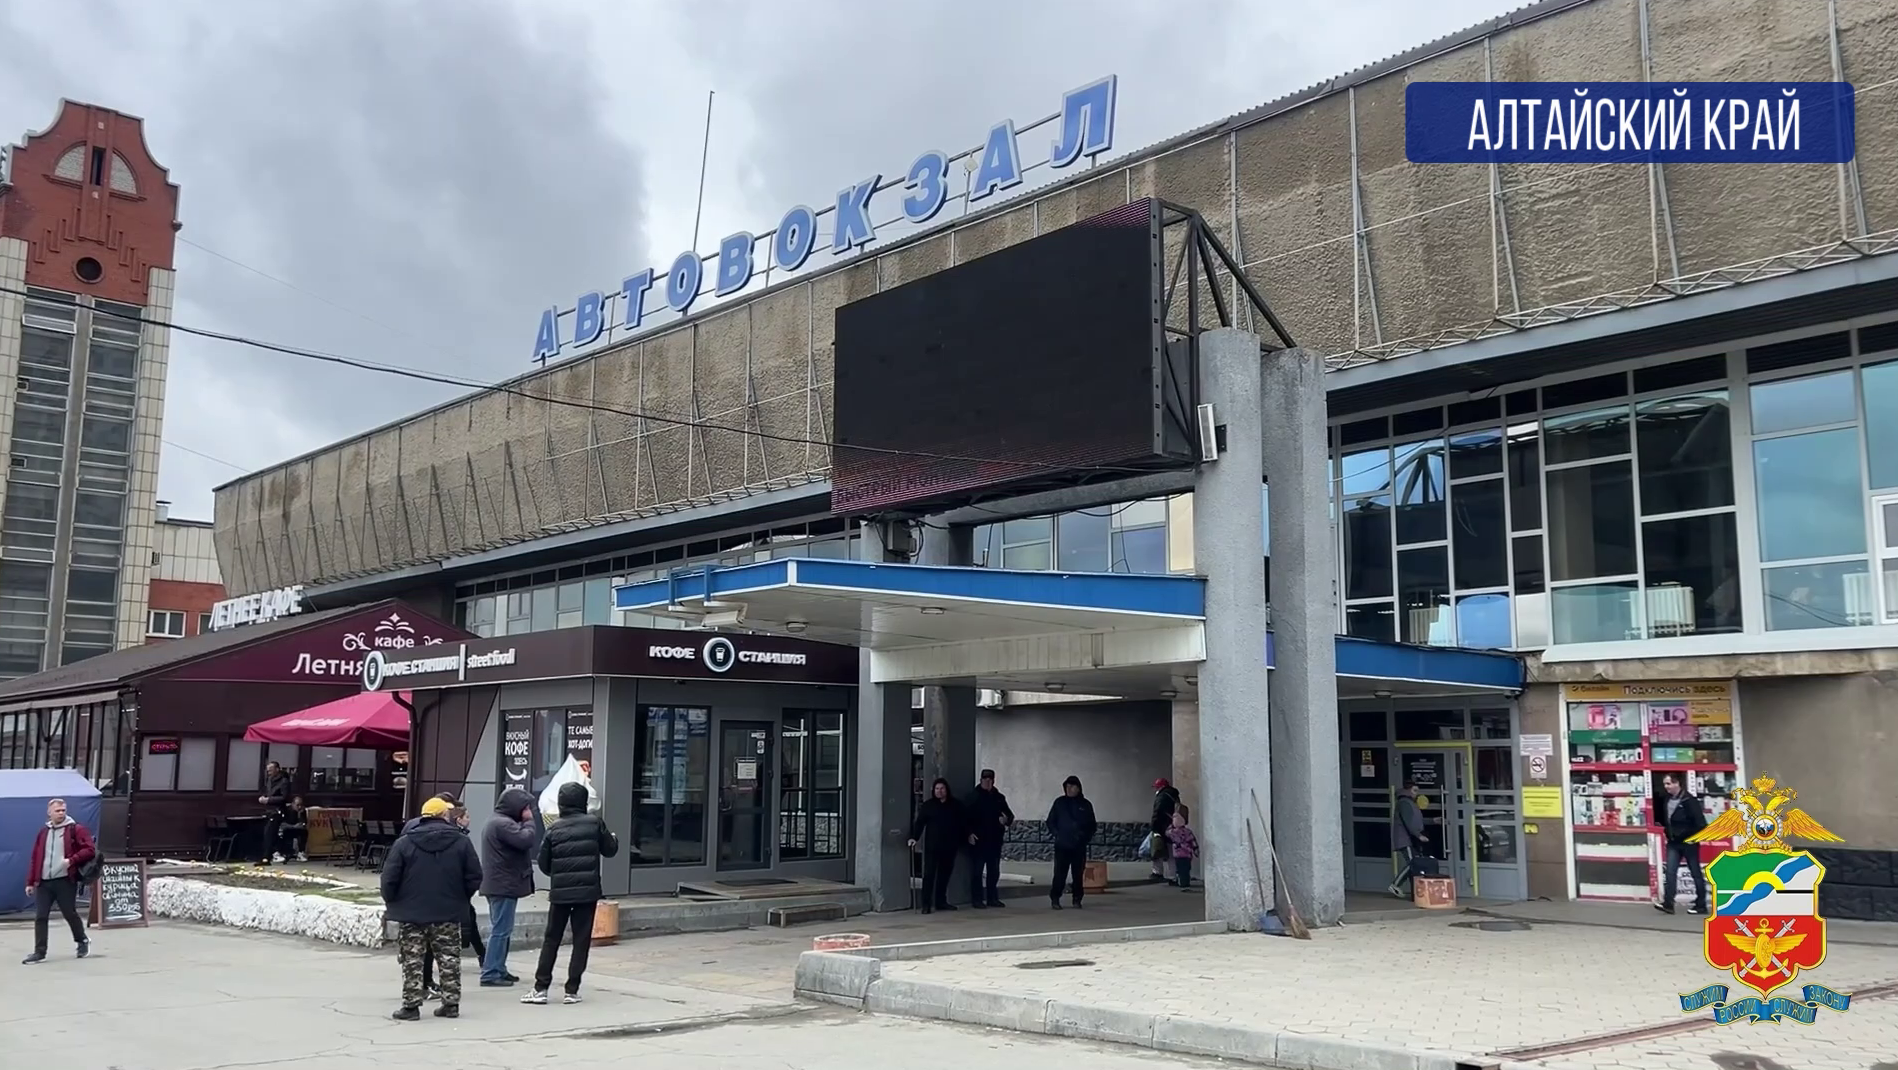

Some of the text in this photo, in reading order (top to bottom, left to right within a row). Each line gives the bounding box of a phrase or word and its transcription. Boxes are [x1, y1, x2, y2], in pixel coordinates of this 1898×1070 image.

[531, 74, 1118, 363] АВТОВОКЗАЛ
[374, 635, 415, 649] кафе
[649, 645, 806, 665] КОФЕ СТАНЦИЯ
[1623, 684, 1692, 694] Подключись
[568, 725, 593, 734] ТЕ САМЫЕ
[505, 741, 528, 755] КОФЕ
